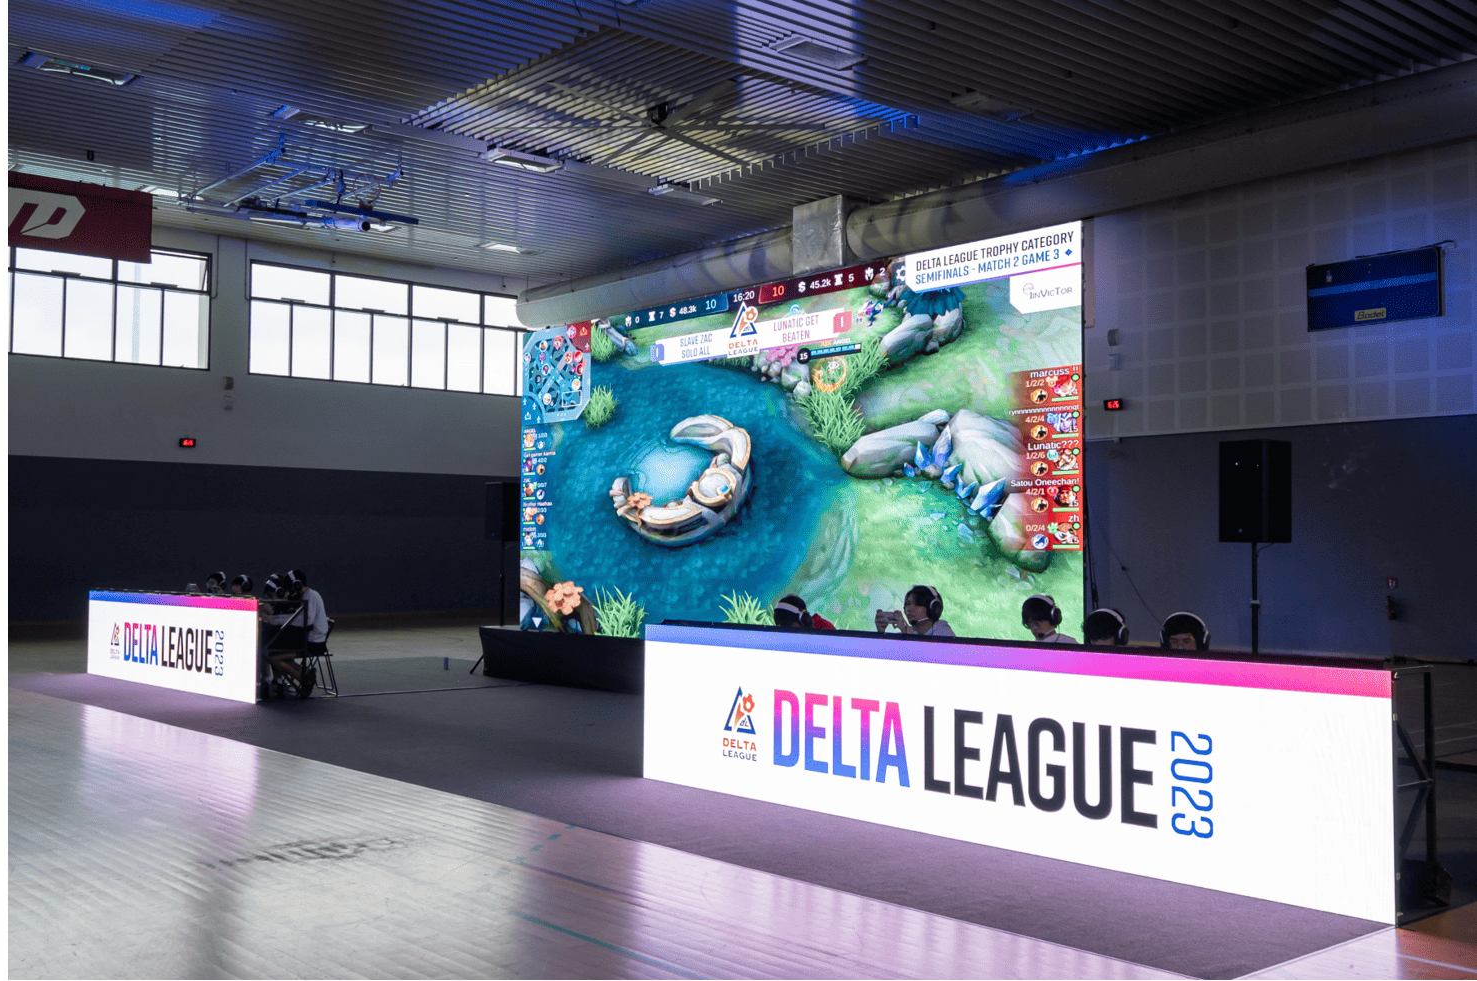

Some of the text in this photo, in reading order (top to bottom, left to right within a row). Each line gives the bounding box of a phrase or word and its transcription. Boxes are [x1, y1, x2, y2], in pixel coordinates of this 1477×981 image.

[916, 231, 1074, 271] DELTA LEAGUE TROPHY CATEGORY
[915, 265, 969, 285] SEMIFINALS
[978, 258, 1011, 273] MATCH
[1013, 256, 1019, 267] 2
[1021, 251, 1051, 265] GAME
[1053, 249, 1060, 260] 3
[659, 311, 664, 319] 7
[679, 305, 697, 315] 48.3k
[705, 299, 717, 310] 10
[733, 290, 755, 302] 16:20
[772, 285, 785, 297] 10
[810, 278, 832, 290] 45.2k
[848, 273, 855, 282] 5
[879, 267, 886, 276] 2
[773, 314, 819, 332] LUNATIC GET
[680, 333, 713, 347] SLAVE ZAC
[782, 330, 810, 343] BEATEN
[728, 339, 758, 350] DELTA
[681, 346, 711, 359] SOLO ALL
[728, 347, 759, 356] LEAGUE
[799, 352, 808, 360] 15
[1030, 368, 1070, 379] marcuss
[1025, 380, 1045, 388] 1/2/2
[1025, 415, 1045, 423] 4/2/4
[1027, 440, 1079, 450] Lunatic???
[1068, 514, 1080, 522] zh
[1025, 524, 1046, 532] 0/2/4
[124, 622, 224, 676] DELTA LEAGUE 2023
[723, 737, 757, 752] DELTA
[723, 749, 757, 762] LEAGUE
[773, 688, 1213, 839] DELTA LEAGUE 2023
